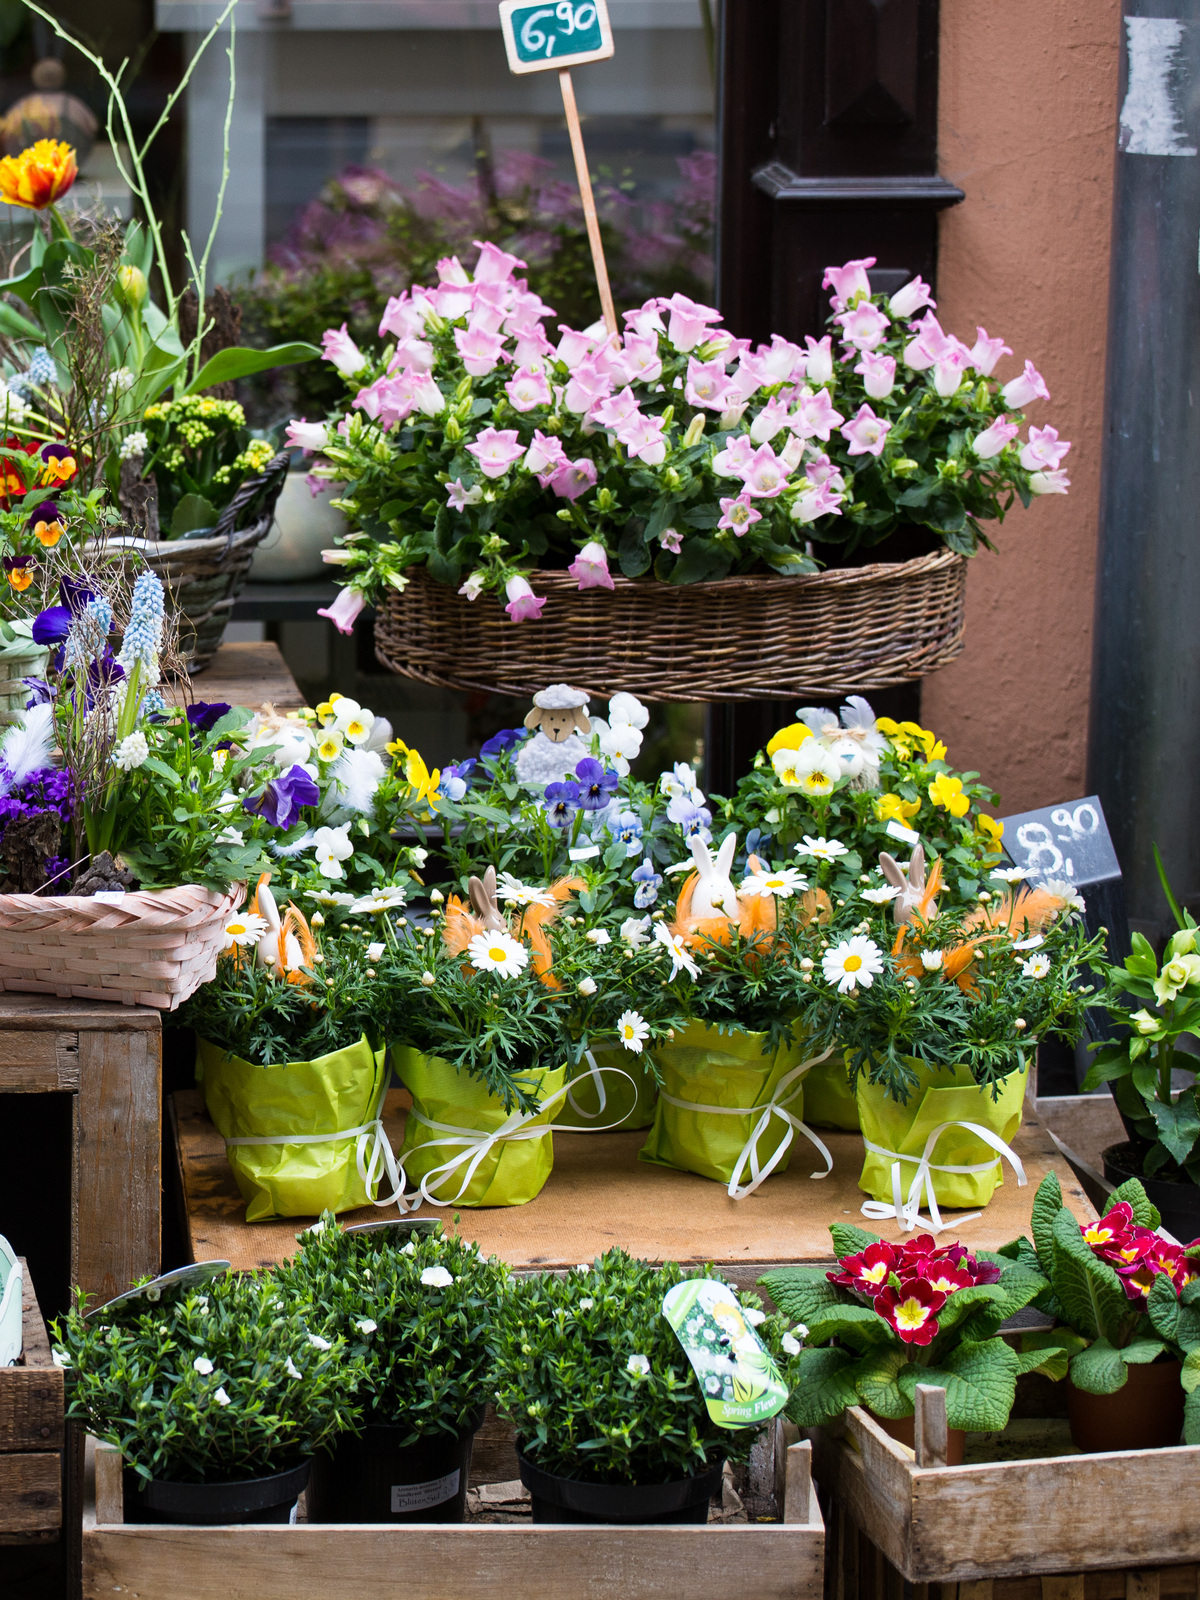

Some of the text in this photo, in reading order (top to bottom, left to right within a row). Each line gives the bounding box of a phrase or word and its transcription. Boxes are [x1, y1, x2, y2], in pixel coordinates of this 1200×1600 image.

[520, 1, 597, 58] 6,90
[722, 1395, 777, 1419] Spring Fleur
